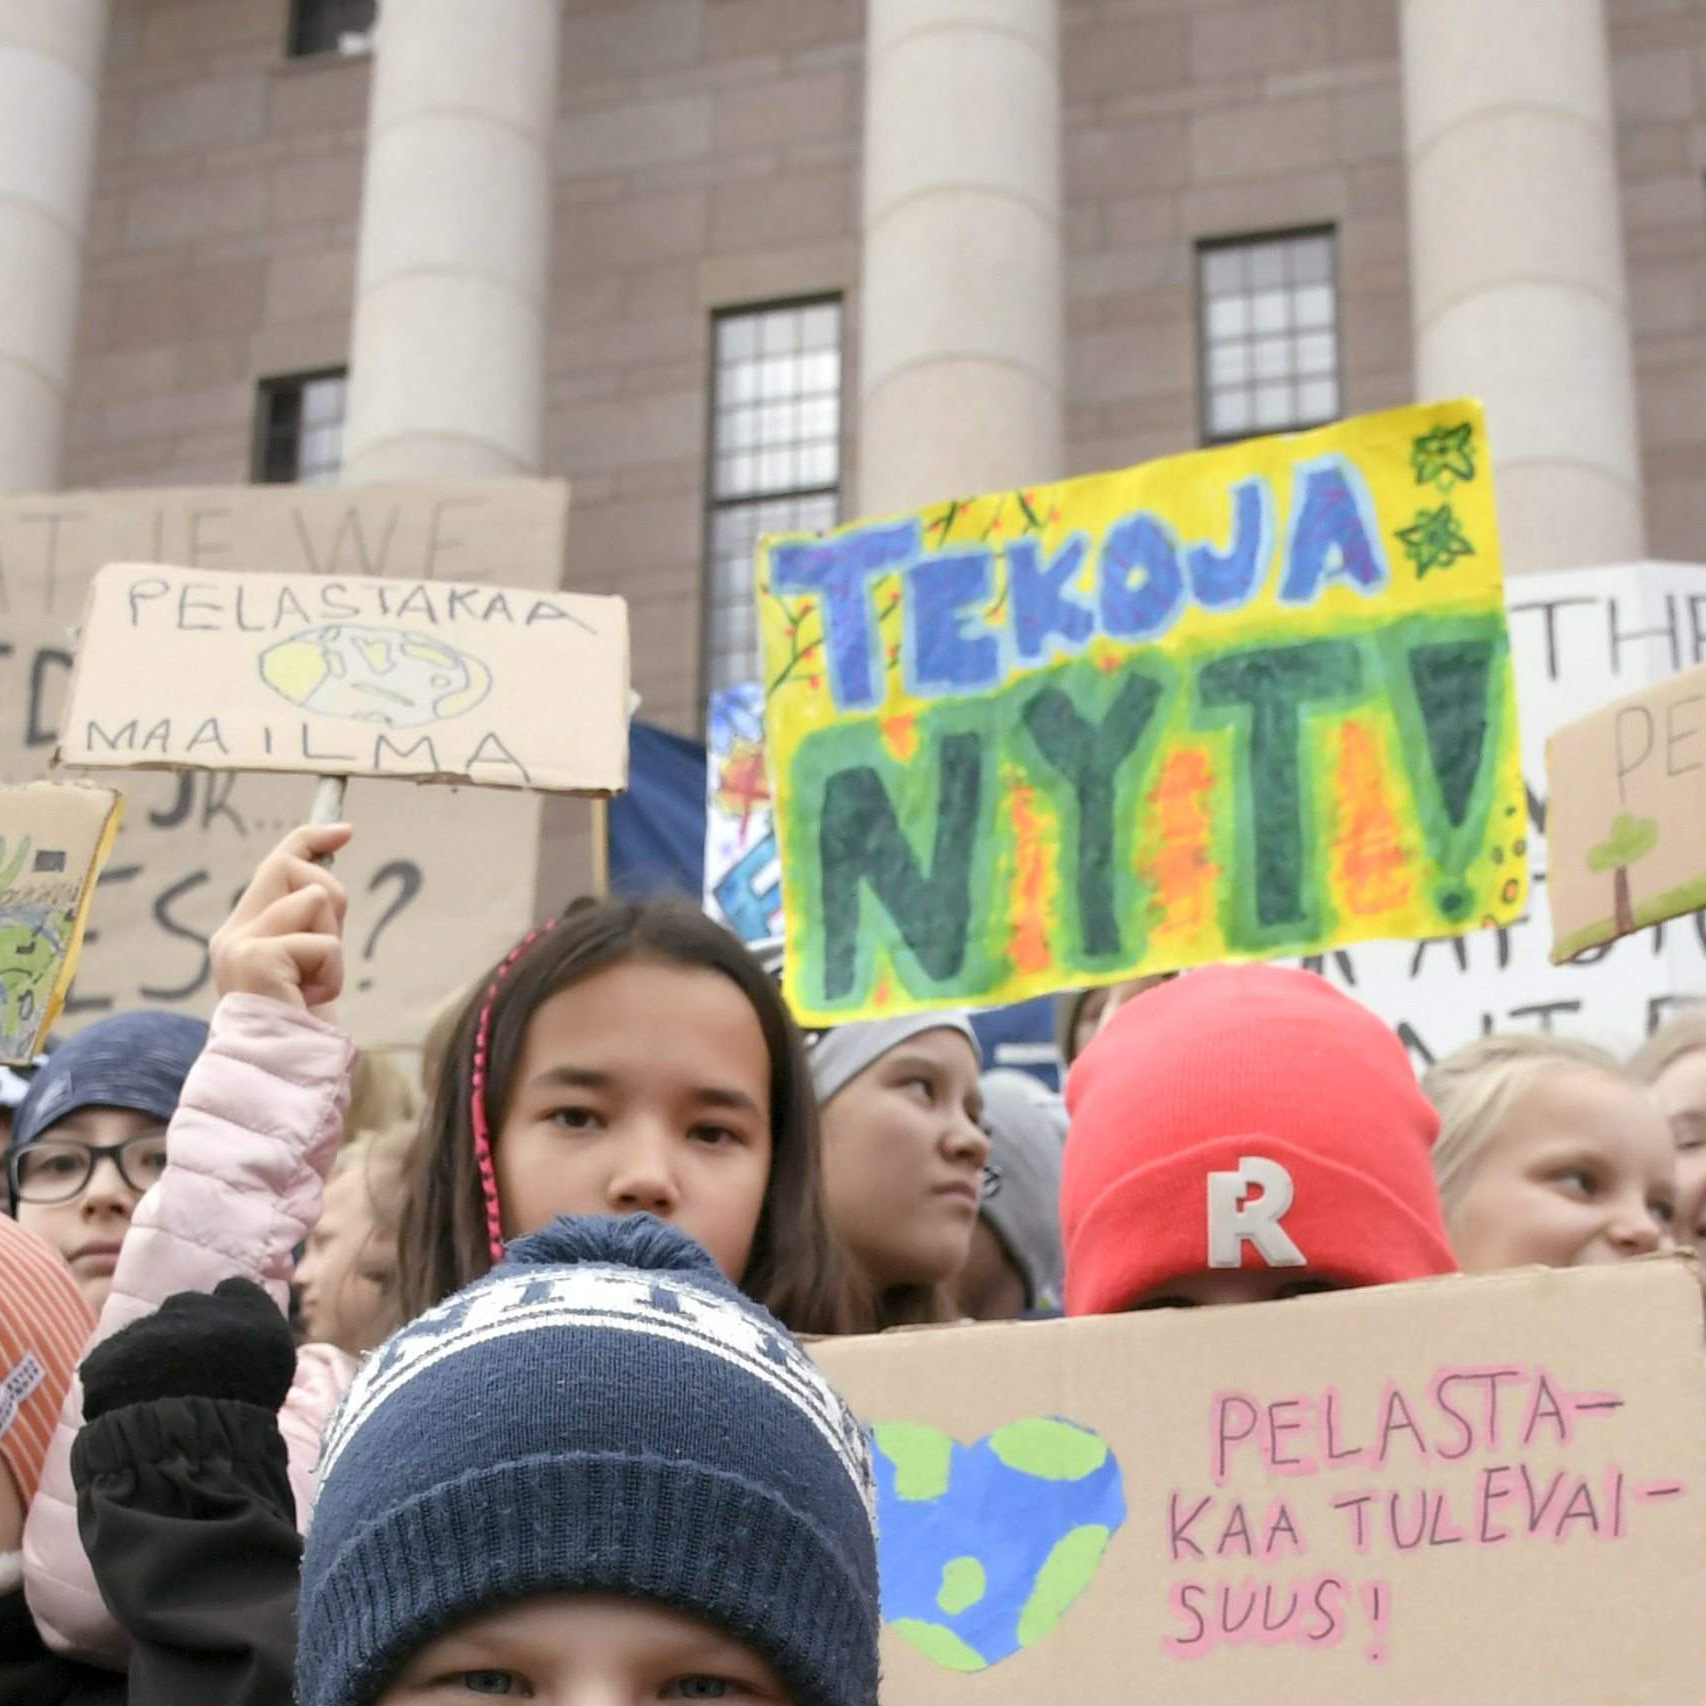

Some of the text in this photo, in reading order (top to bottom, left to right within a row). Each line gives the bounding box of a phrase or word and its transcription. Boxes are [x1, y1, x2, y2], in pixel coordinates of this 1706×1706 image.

[127, 576, 599, 634] PELASTAKAA
[767, 454, 1388, 712] TEKOJA
[85, 716, 533, 784] MAAILMA
[813, 635, 1497, 1003] NYT!
[1205, 1155, 1309, 1270] R
[1213, 1368, 1627, 1486] PELASTA-
[1169, 1464, 1685, 1560] KAA TULEVAI-
[1175, 1577, 1386, 1662] SUUS!
